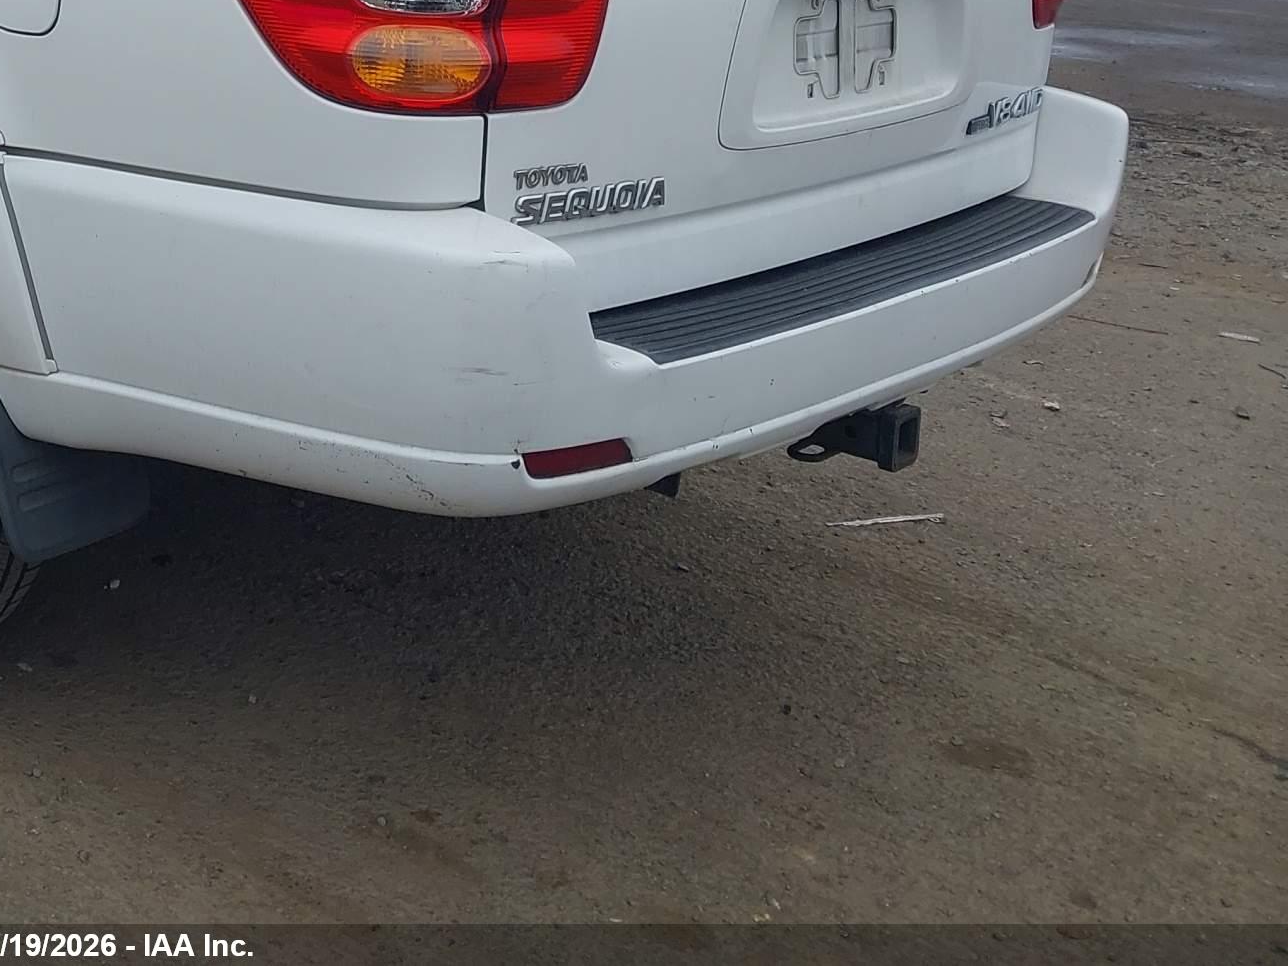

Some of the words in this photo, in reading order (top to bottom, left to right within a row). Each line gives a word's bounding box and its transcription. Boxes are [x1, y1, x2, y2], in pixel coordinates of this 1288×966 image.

[987, 97, 1012, 129] V8
[514, 163, 588, 190] TOYOTA
[511, 176, 665, 226] SEQUOIA
